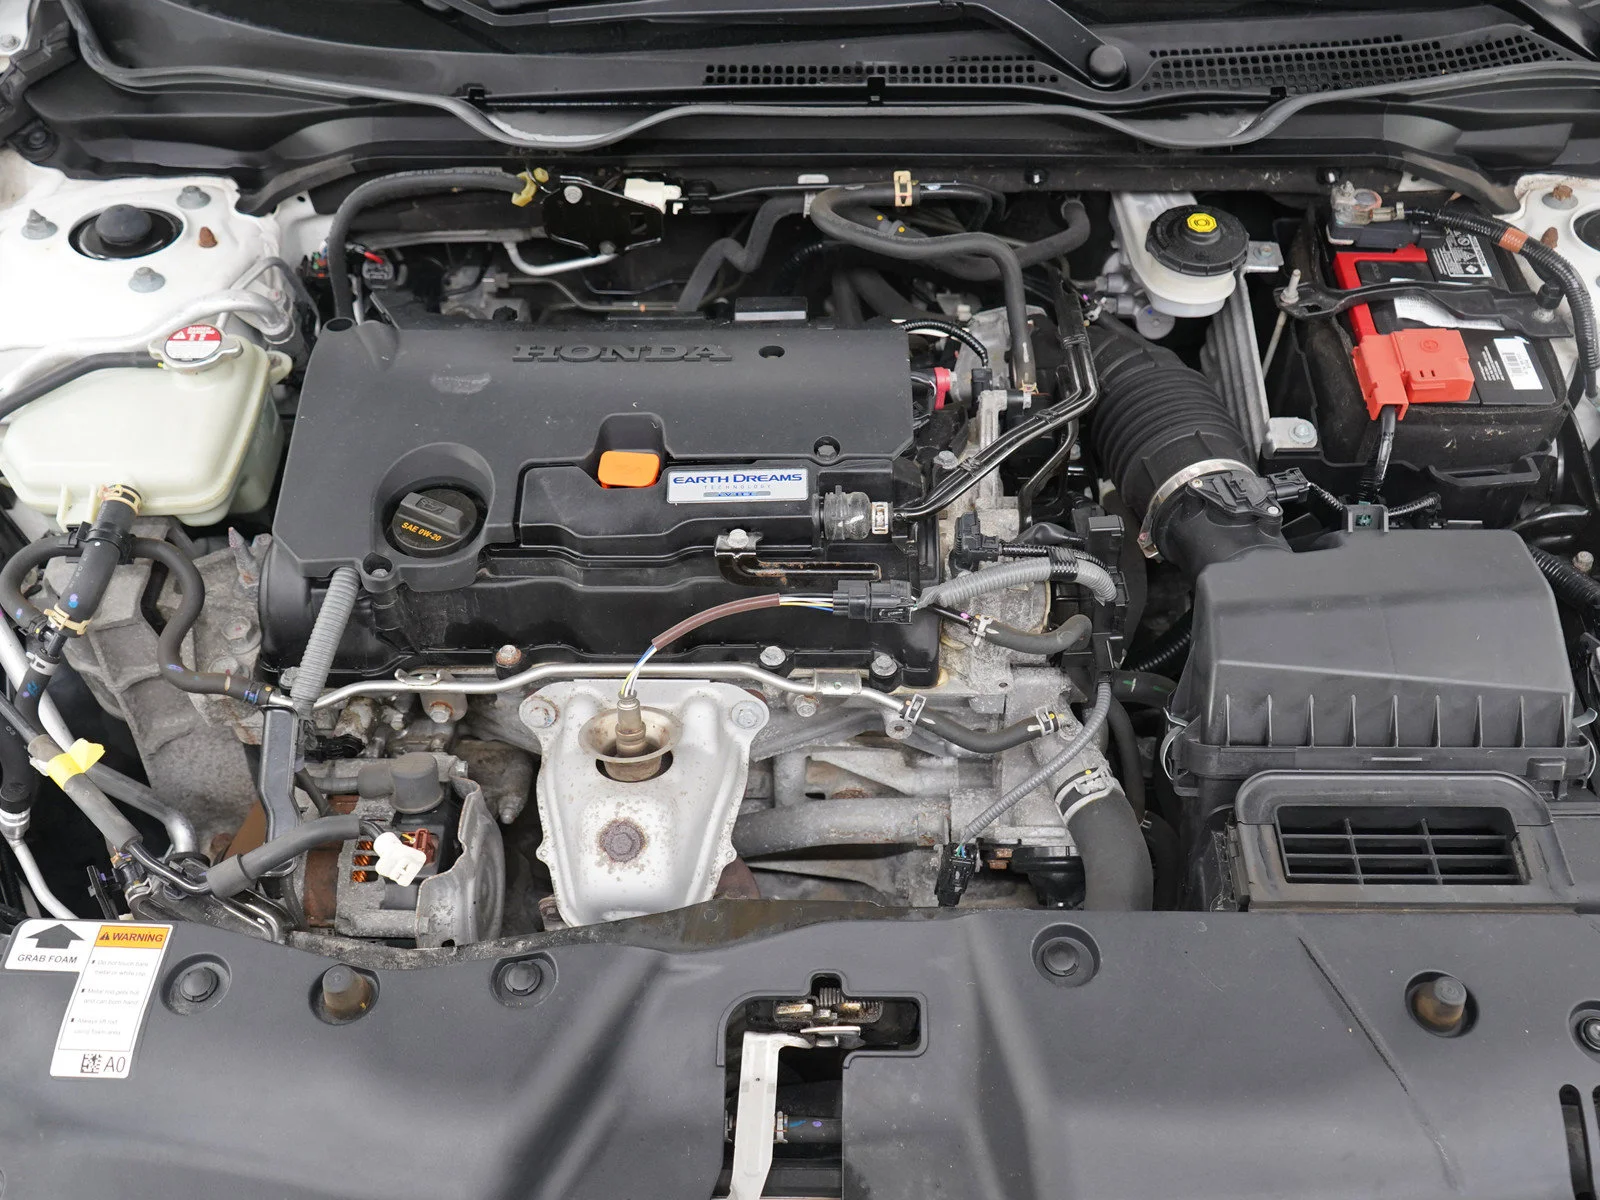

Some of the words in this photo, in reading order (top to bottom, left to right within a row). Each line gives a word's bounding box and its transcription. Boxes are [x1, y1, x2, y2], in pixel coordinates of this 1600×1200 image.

[512, 344, 733, 362] HONDA
[673, 475, 729, 484] EARTH
[733, 473, 803, 483] DREAMS
[401, 522, 419, 532] SAE
[418, 529, 442, 542] 0W-20
[112, 932, 163, 942] WARNING
[17, 954, 46, 963] GRAB
[48, 955, 78, 964] FOAM
